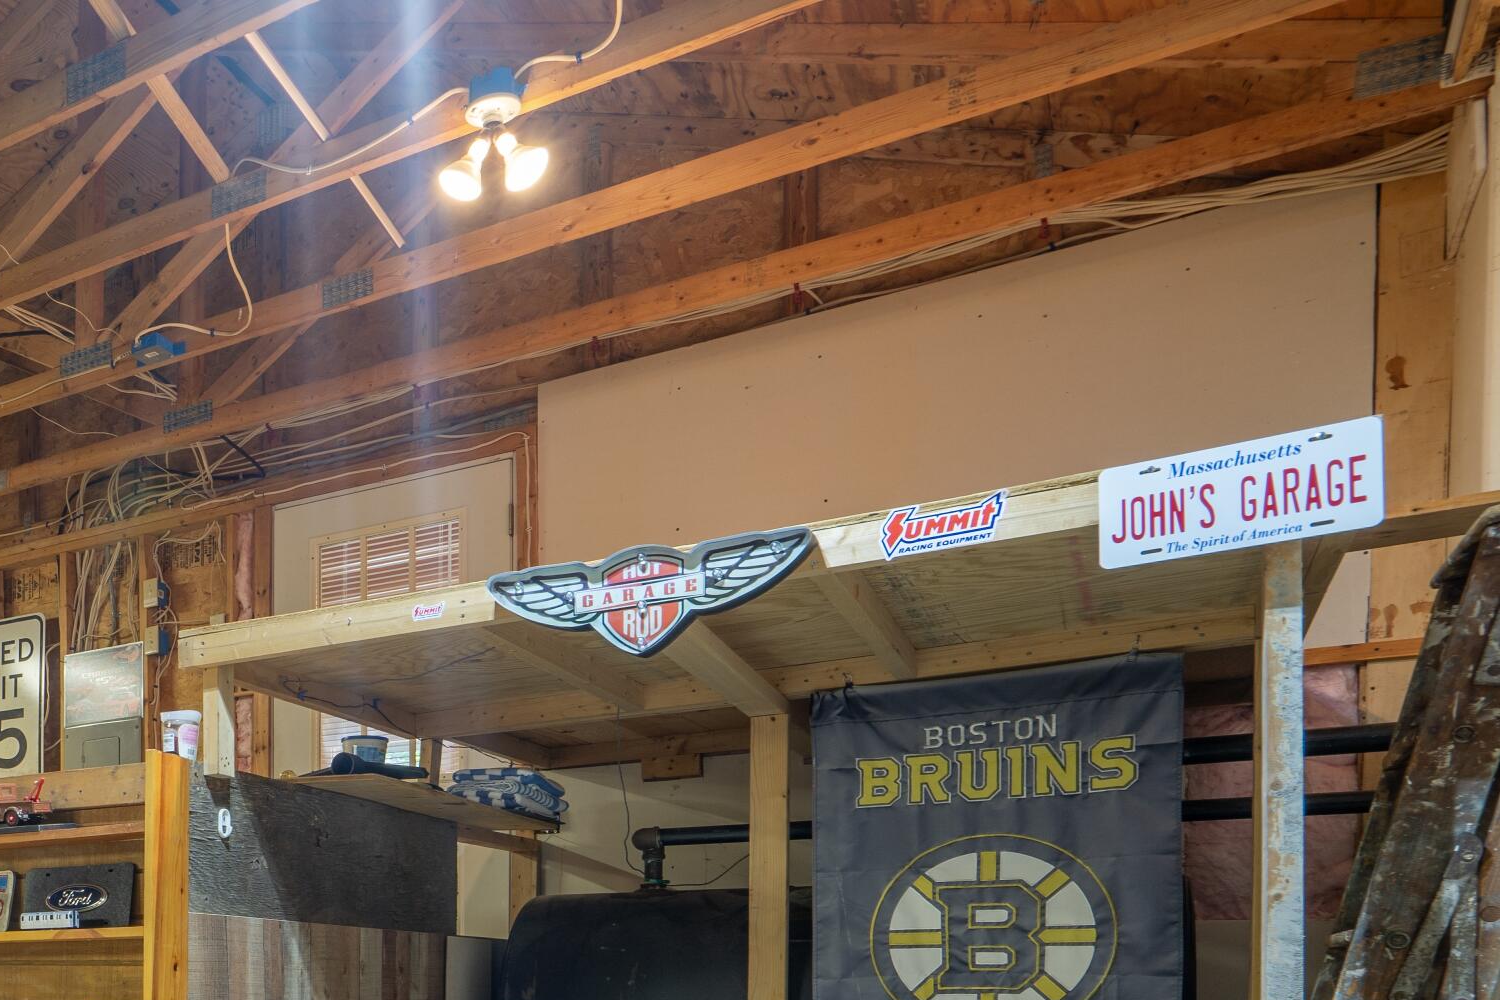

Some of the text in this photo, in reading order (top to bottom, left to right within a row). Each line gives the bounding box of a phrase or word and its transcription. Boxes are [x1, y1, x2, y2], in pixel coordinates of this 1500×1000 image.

[1167, 443, 1302, 480] Massachusetts
[1112, 454, 1368, 544] JOHN'S GARAGE
[898, 532, 992, 554] RACING EQUIPMENT
[1167, 523, 1303, 554] The Spirit of America
[622, 562, 662, 580] HOT
[582, 579, 698, 608] GARAGE
[623, 605, 662, 639] ROD
[923, 714, 1057, 749] BOSTON
[855, 734, 1139, 809] BRUINS
[58, 889, 92, 905] Ford
[934, 883, 1042, 990] B
